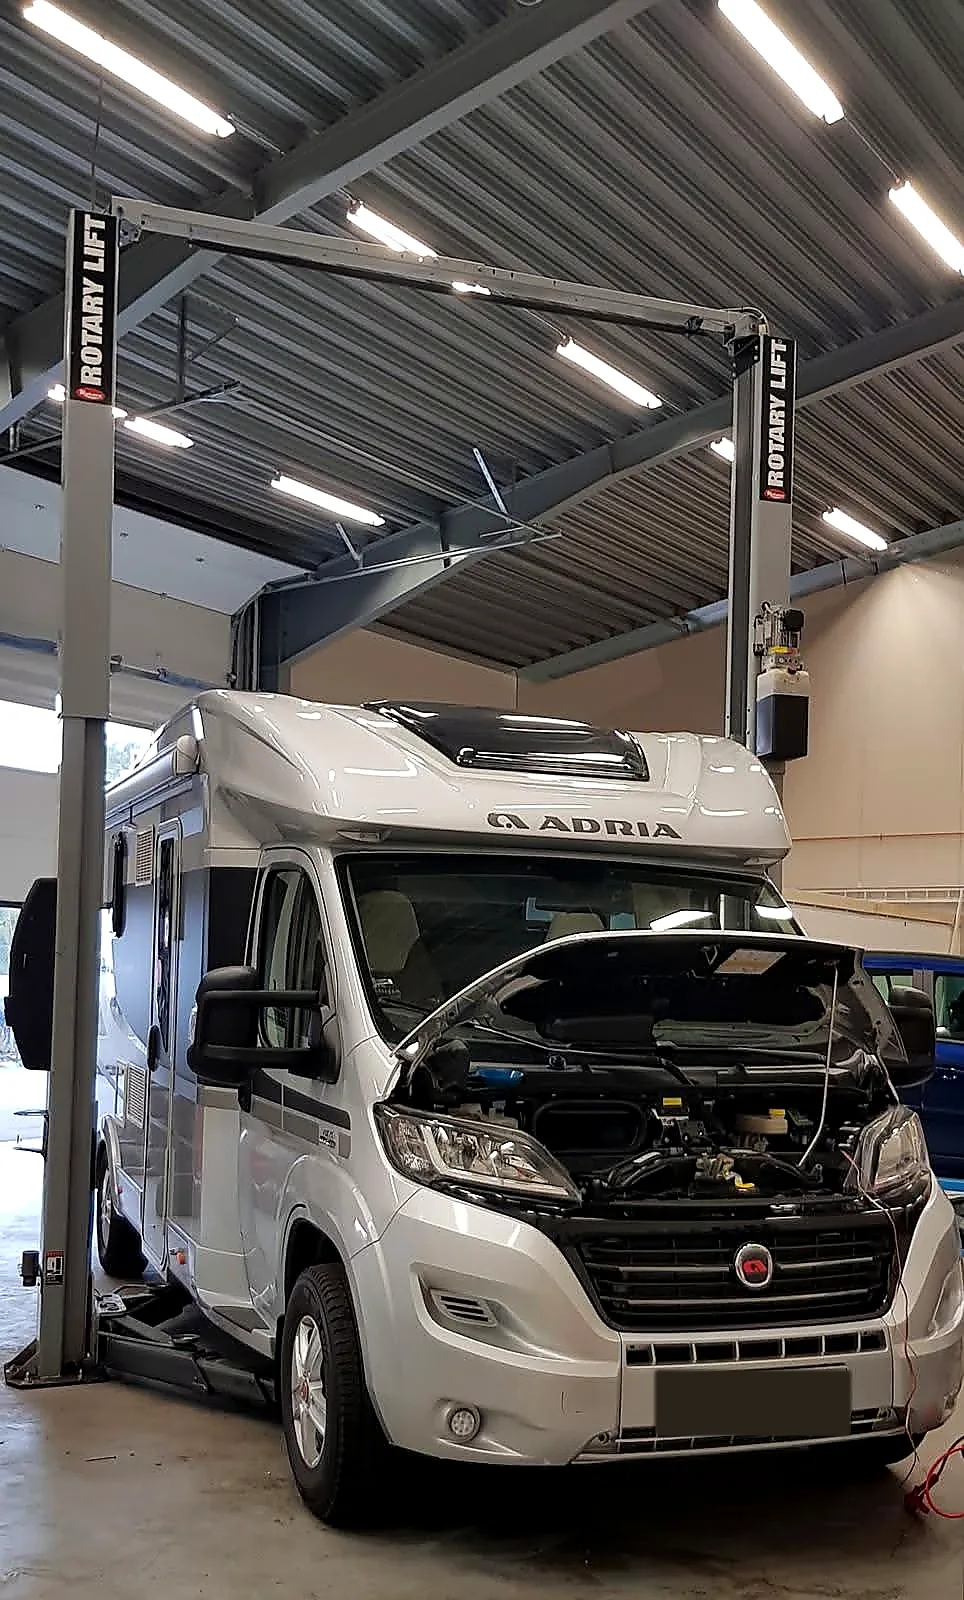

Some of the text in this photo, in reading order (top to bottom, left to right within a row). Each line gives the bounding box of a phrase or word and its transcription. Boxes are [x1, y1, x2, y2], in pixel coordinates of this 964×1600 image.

[83, 213, 106, 273] LIFT
[80, 276, 105, 386] ROTARY
[770, 338, 787, 390] LIFT
[767, 393, 786, 488] ROTARY
[539, 815, 682, 839] ADRIA
